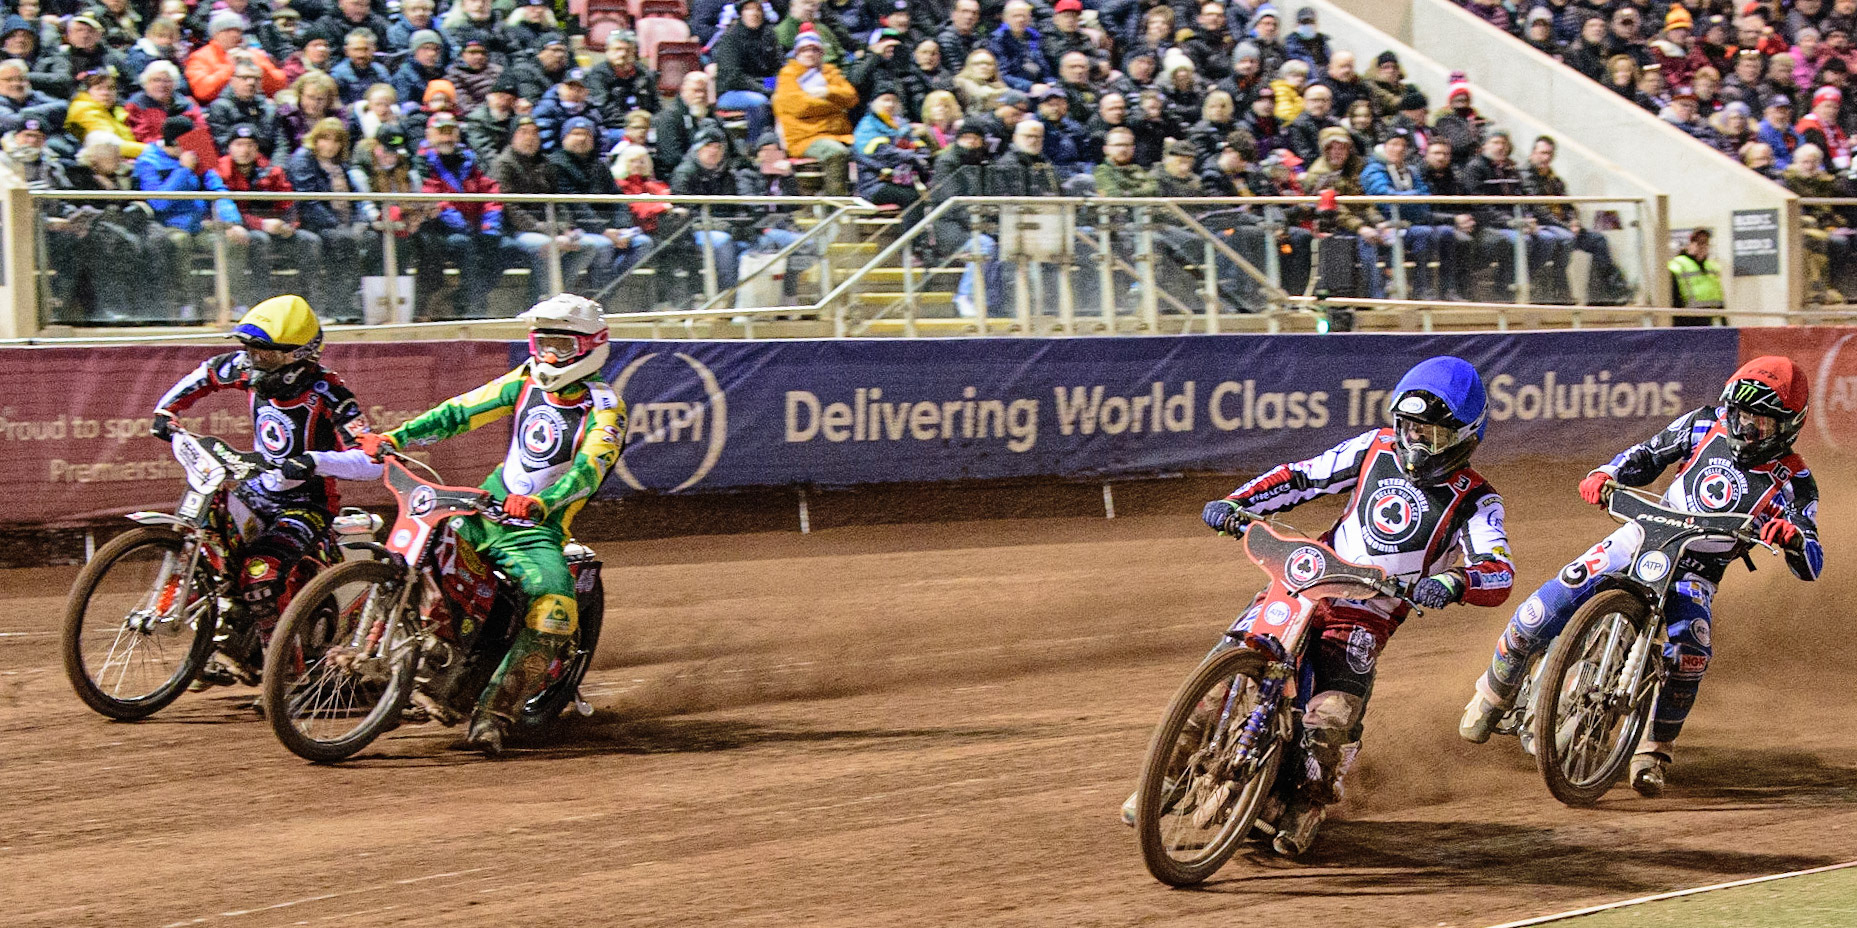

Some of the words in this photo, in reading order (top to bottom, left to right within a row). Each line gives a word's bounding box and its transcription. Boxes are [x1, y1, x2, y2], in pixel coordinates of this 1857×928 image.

[785, 386, 1038, 452] Delivering
[1053, 381, 1195, 436] World
[1209, 379, 1330, 432] Class
[1489, 370, 1683, 422] Solutions
[72, 415, 100, 439] to
[209, 408, 250, 435] the
[625, 402, 705, 444] ATPI
[1708, 457, 1732, 467] PETER
[1772, 462, 1791, 481] 16
[1378, 477, 1406, 488] PETER
[1454, 475, 1471, 492] 3
[1704, 468, 1723, 477] BELLE
[1724, 470, 1735, 482] VUE
[1732, 483, 1740, 501] ACES
[1375, 488, 1397, 501] BELLE
[1398, 489, 1413, 502] VUE
[1410, 502, 1420, 521] ACES
[1642, 560, 1664, 571] ATPI
[1526, 603, 1538, 621] ATPI
[1682, 656, 1707, 666] NGK
